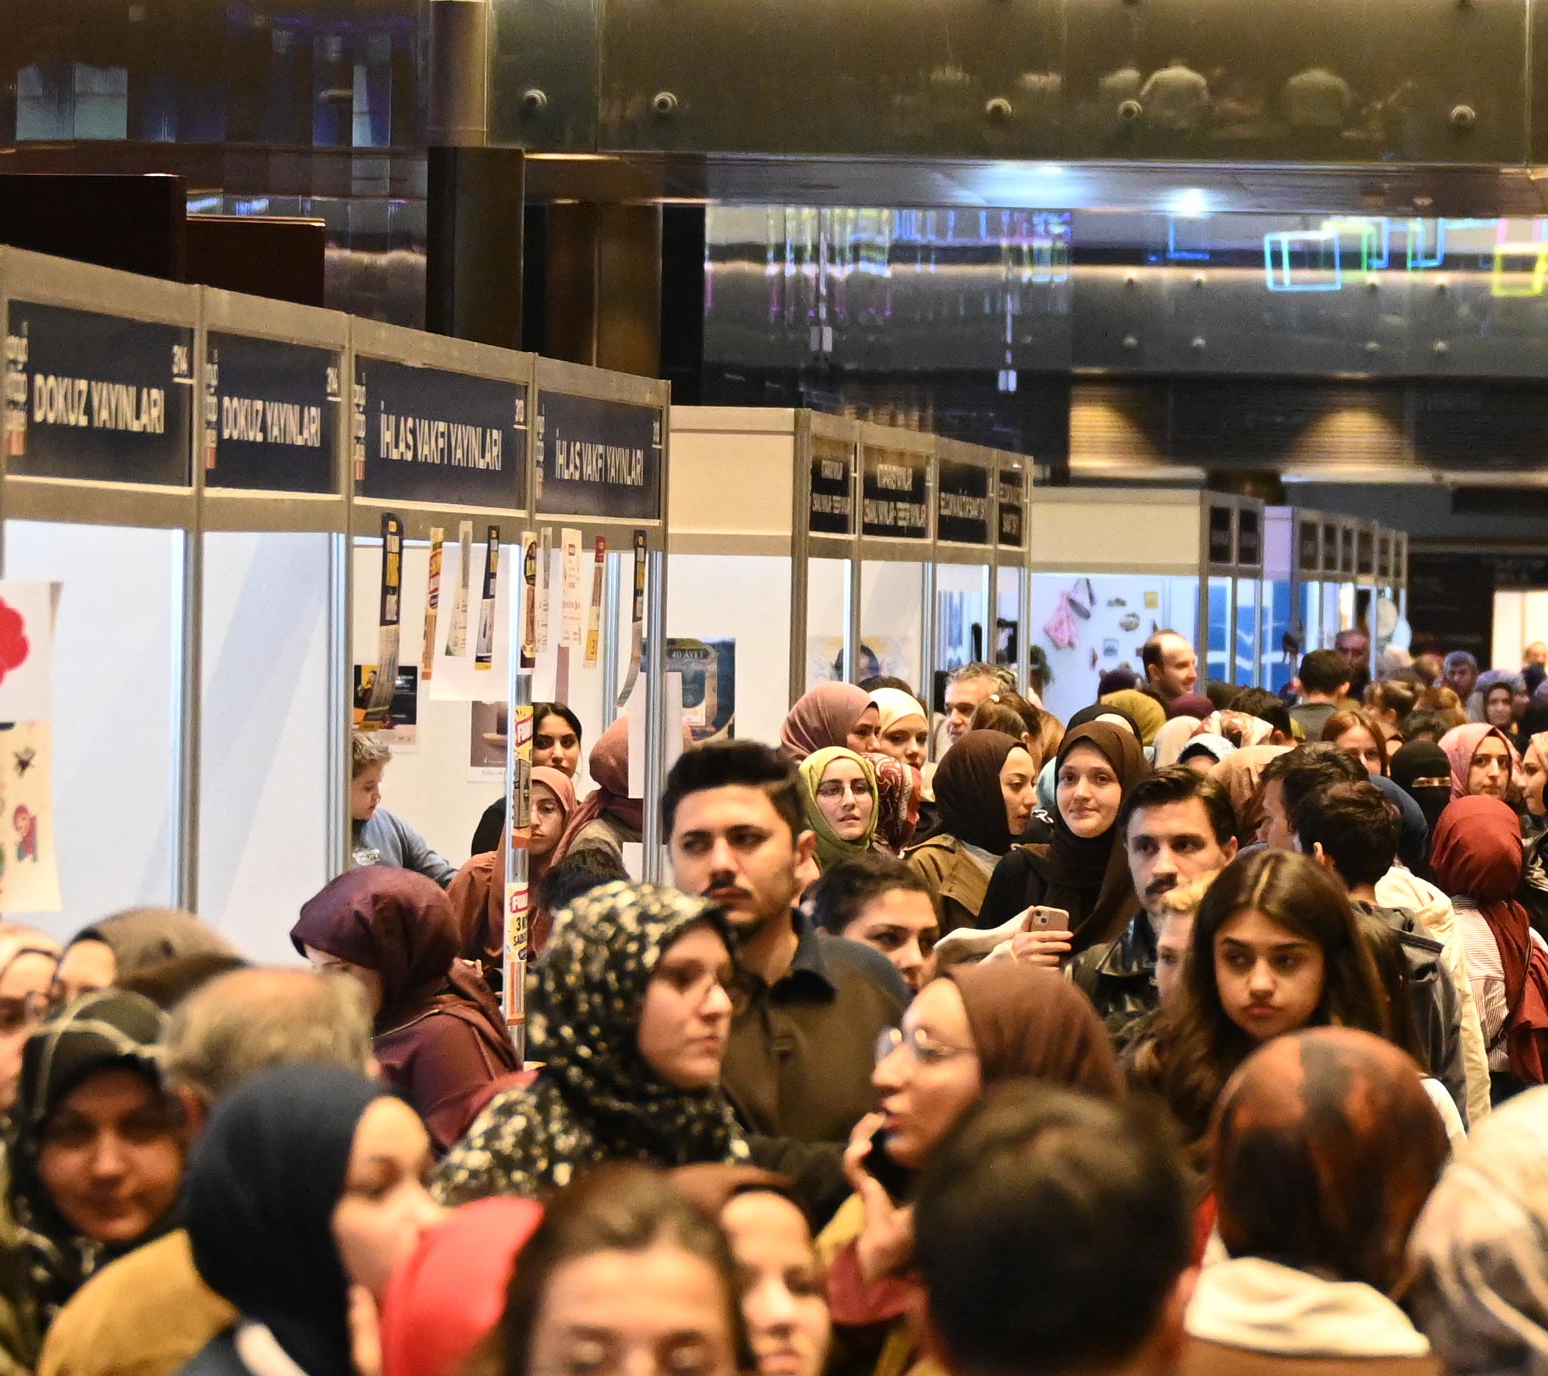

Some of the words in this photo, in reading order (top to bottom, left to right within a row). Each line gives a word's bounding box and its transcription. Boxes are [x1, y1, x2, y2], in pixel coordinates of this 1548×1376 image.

[33, 373, 88, 427] DOKUZ
[90, 380, 164, 434] YAYINLARI
[222, 396, 264, 442] DOKUZ
[265, 401, 320, 447] YAYINLARI
[381, 400, 414, 462] İHLAS
[415, 418, 448, 465] VAKFI
[450, 423, 502, 471] YAYINLARI
[555, 428, 580, 480] İHLAS
[606, 445, 644, 486] YAYINLARI
